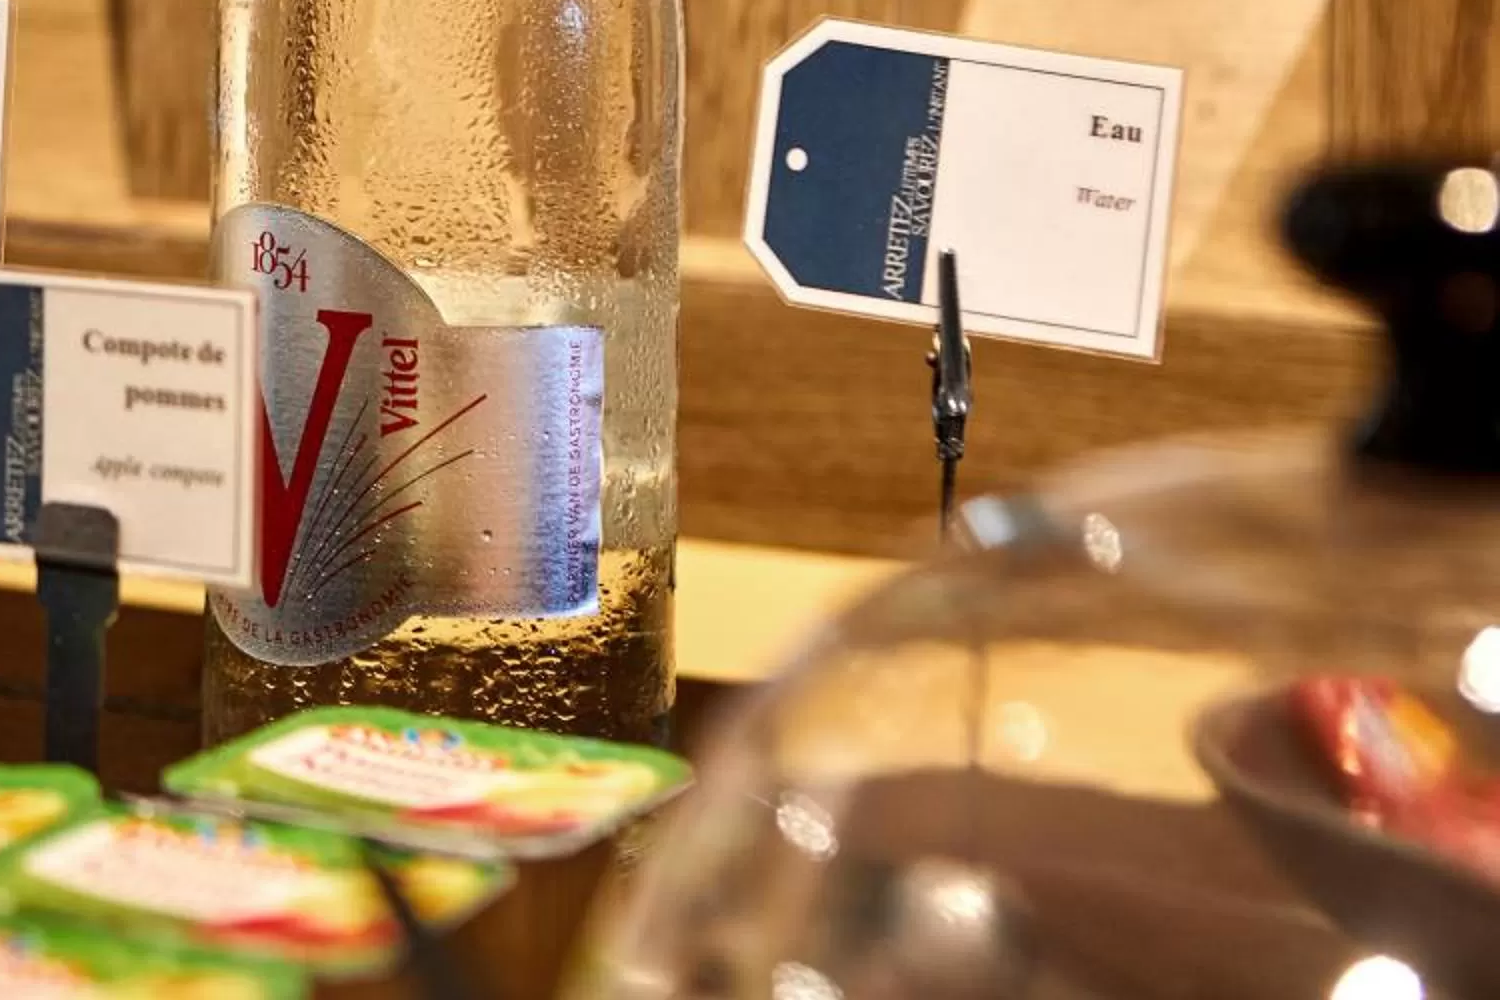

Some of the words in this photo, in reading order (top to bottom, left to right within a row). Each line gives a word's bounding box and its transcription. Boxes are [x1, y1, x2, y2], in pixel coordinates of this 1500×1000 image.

[1088, 114, 1145, 144] Eau
[1076, 186, 1137, 212] Water
[252, 230, 311, 294] 1854
[82, 330, 192, 365] Compote
[197, 340, 225, 364] de
[124, 385, 225, 412] pommes
[380, 336, 421, 437] Vittel
